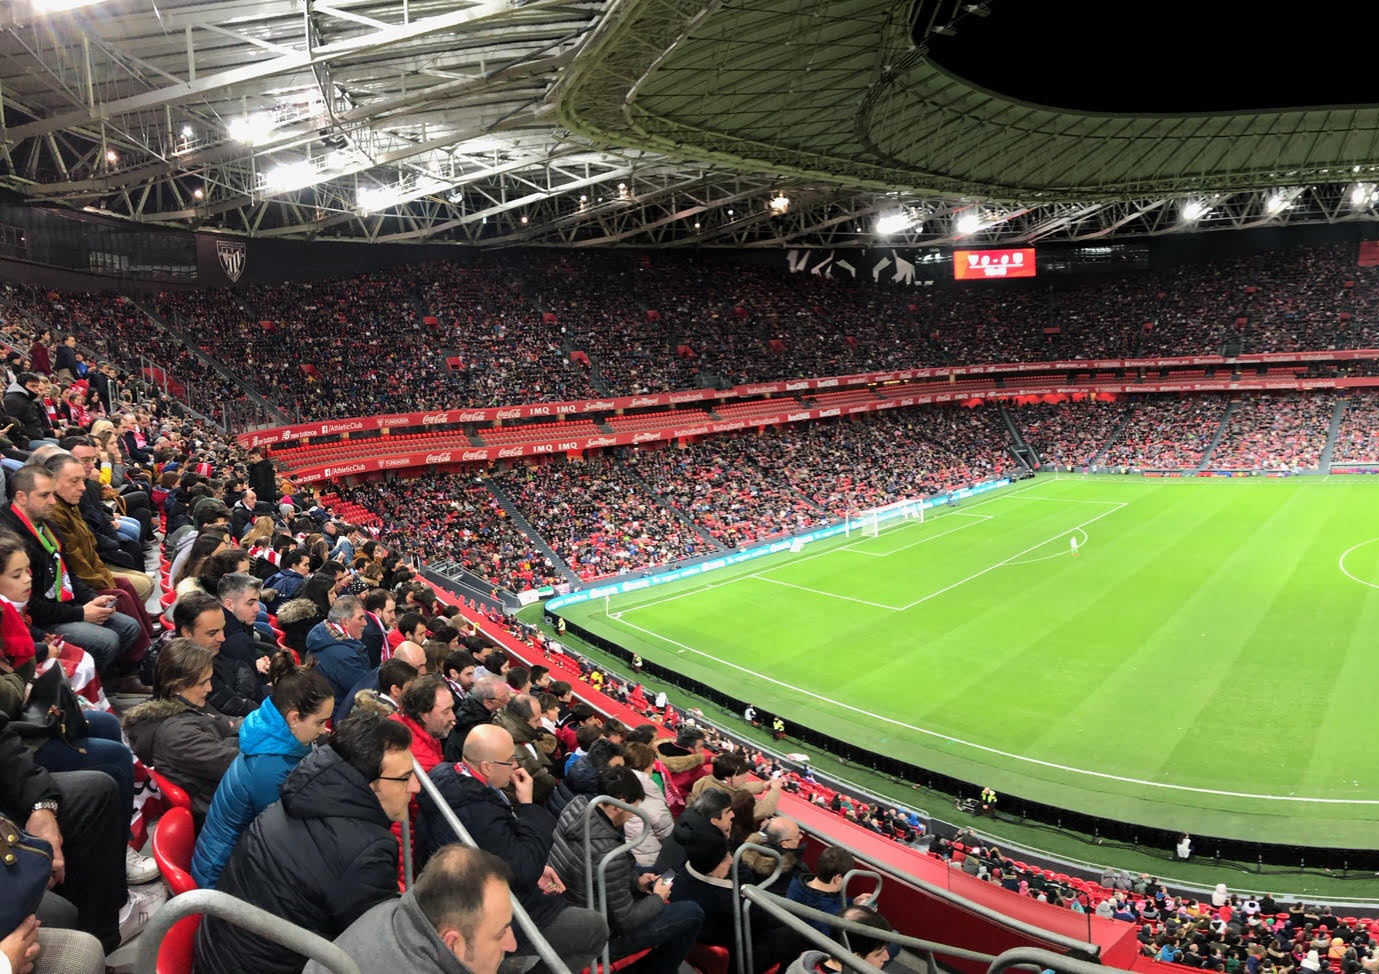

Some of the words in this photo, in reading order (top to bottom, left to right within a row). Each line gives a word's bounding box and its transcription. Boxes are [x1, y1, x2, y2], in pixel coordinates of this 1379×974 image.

[530, 407, 550, 416] IMQ
[556, 405, 577, 413] IMQ
[299, 430, 317, 438] balance
[533, 444, 553, 453] IMQ
[558, 442, 578, 451] IMQ
[303, 474, 321, 482] balance
